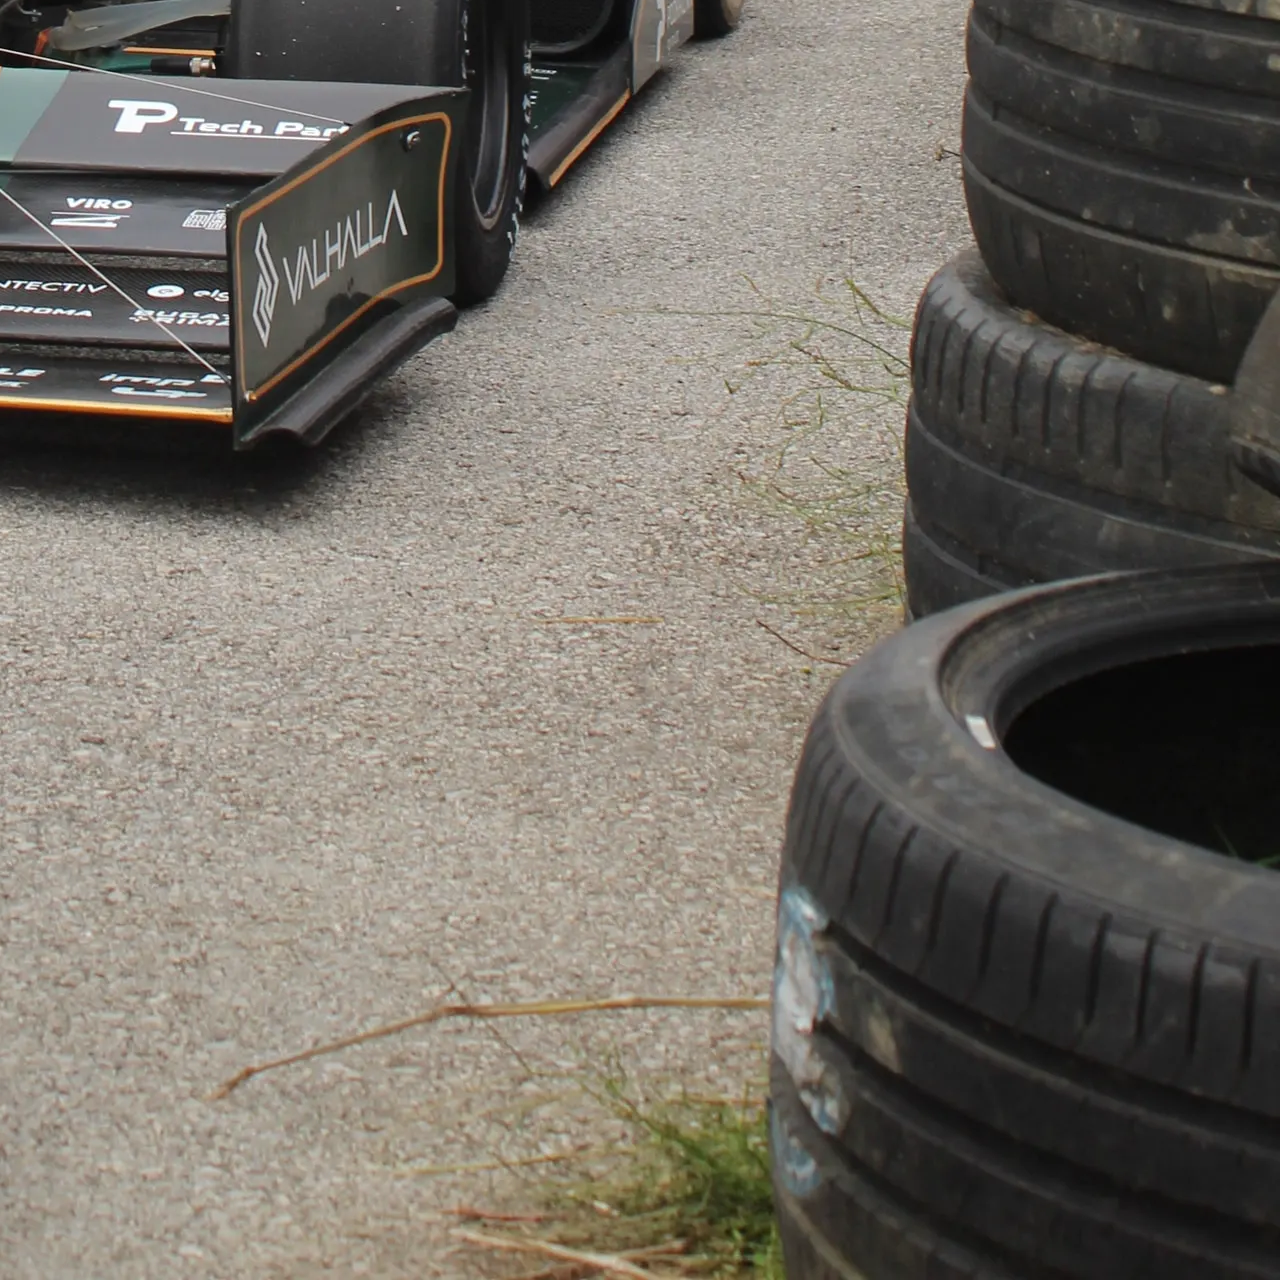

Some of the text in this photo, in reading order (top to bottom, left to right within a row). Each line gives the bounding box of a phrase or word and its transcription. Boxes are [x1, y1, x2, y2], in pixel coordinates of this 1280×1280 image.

[179, 117, 264, 134] Tech
[65, 197, 133, 210] VIRO
[282, 189, 409, 306] VALHALLA
